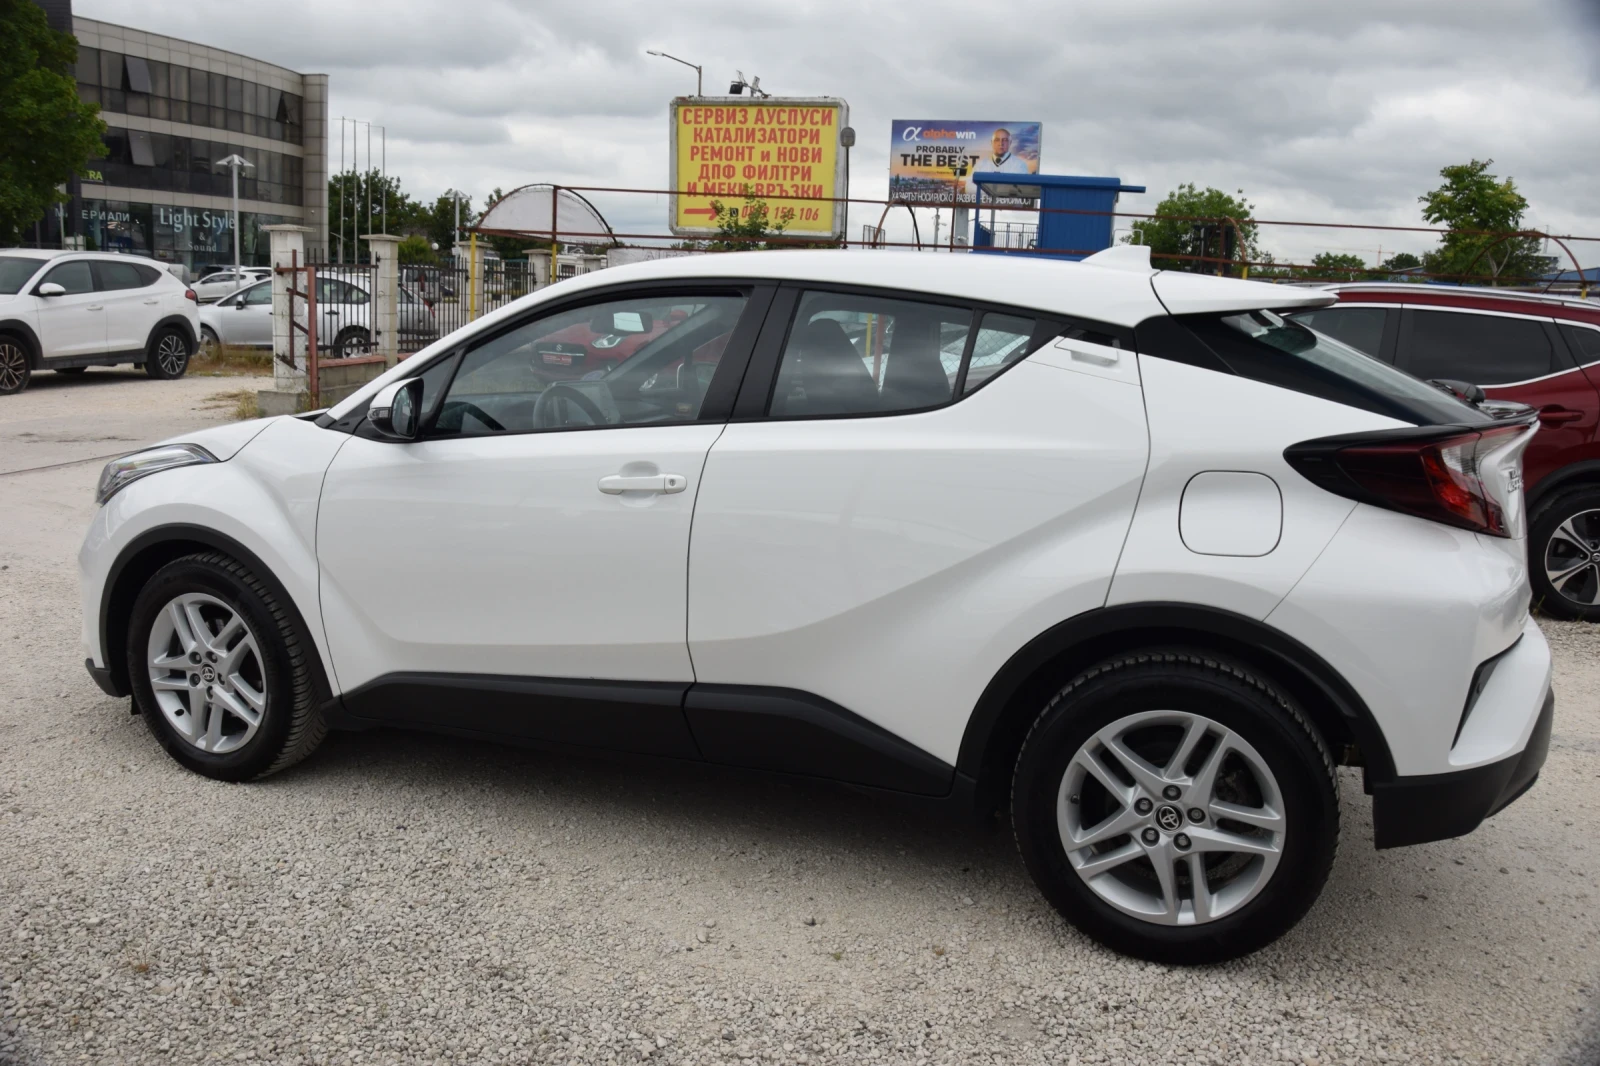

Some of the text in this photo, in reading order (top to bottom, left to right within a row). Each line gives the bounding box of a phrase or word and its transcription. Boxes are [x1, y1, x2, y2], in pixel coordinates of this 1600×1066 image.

[682, 108, 833, 126] СЕРВИЗ АУСПУСИ
[693, 127, 821, 145] КАТАЛИЗАТОРИ
[923, 128, 976, 140] alphawin
[690, 145, 755, 162] РЕМОНТ
[777, 147, 823, 164] НОВИ
[916, 145, 965, 154] PROBABLY
[900, 154, 980, 168] THE BEST
[698, 164, 812, 182] ДПФ ФИЛТРИ
[687, 182, 824, 199] И МЕКИ ВРЪЗКИ
[159, 207, 236, 235] Light Style
[774, 206, 795, 220] 150
[799, 207, 820, 221] 106
[199, 232, 206, 240] &
[188, 242, 217, 253] Sound
